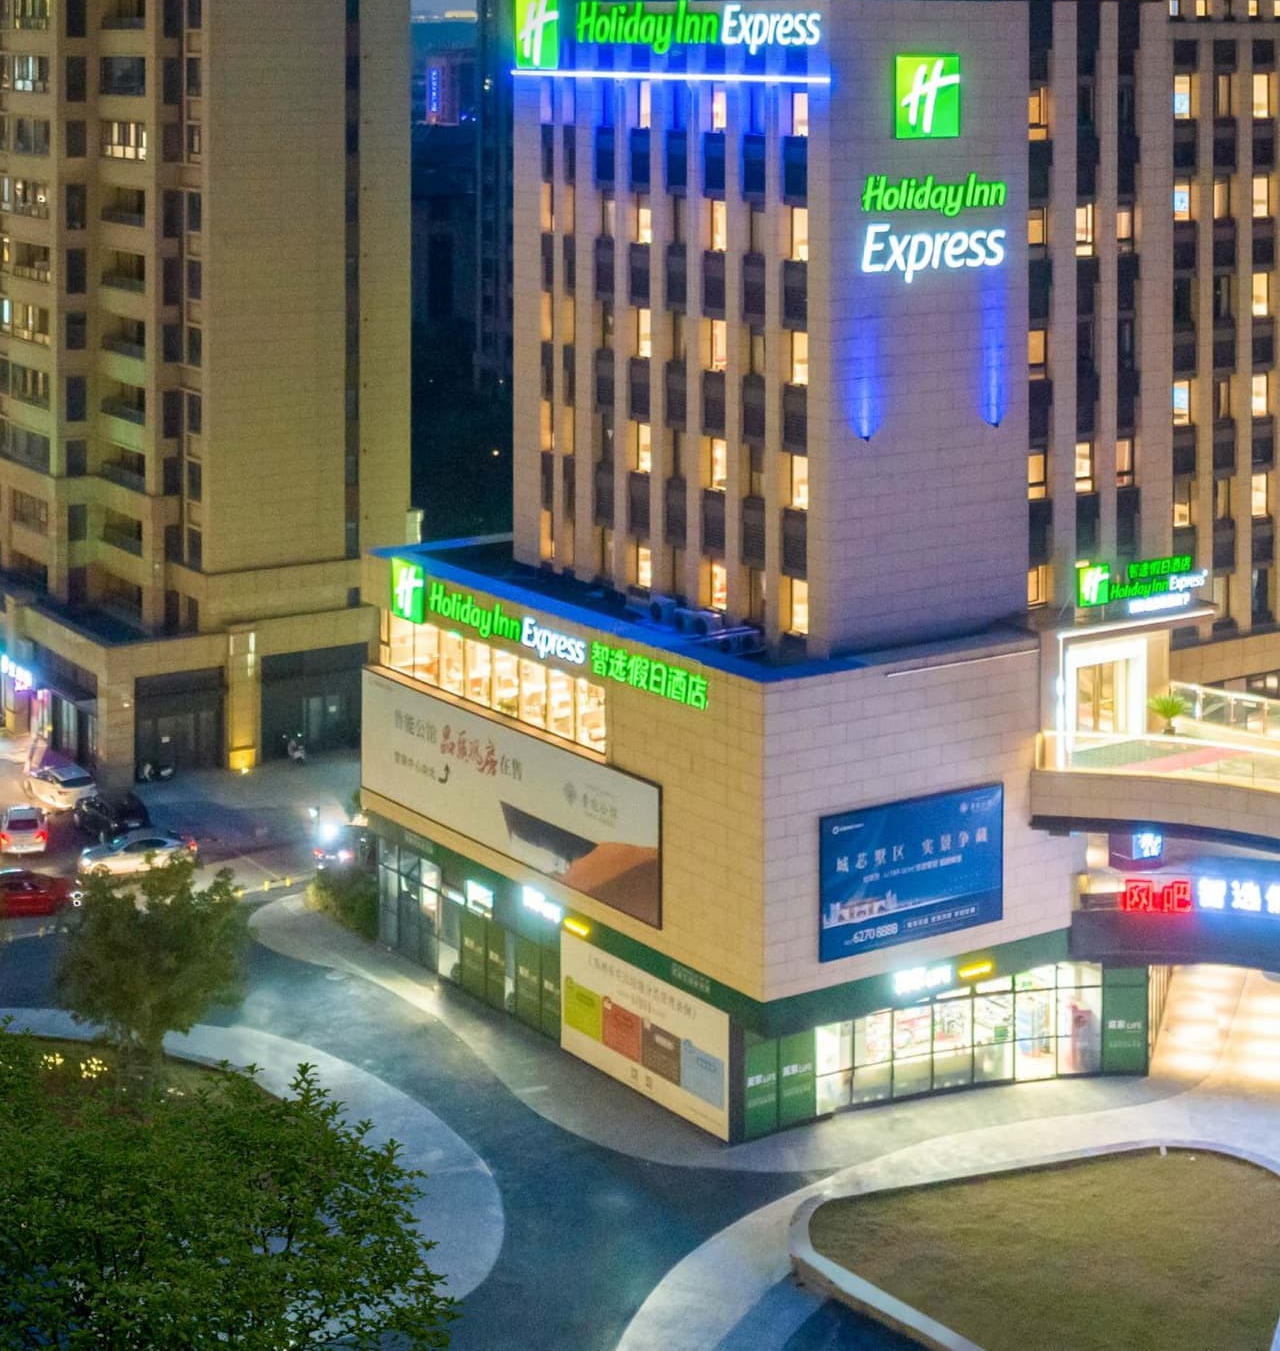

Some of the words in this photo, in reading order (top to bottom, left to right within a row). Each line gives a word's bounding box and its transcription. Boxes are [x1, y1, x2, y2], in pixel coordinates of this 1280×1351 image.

[576, 0, 673, 54] Holiday
[721, 4, 821, 55] Express
[861, 174, 964, 217] Holiday
[965, 172, 1007, 207] Inn
[861, 223, 1006, 284] Express
[1110, 582, 1151, 599] Holiday
[1151, 579, 1168, 592] Inn
[429, 582, 492, 638] Holiday
[493, 603, 521, 641] Inn
[521, 615, 587, 665] Express
[591, 641, 708, 710] 智选假日酒店
[1125, 880, 1192, 912] 网吧
